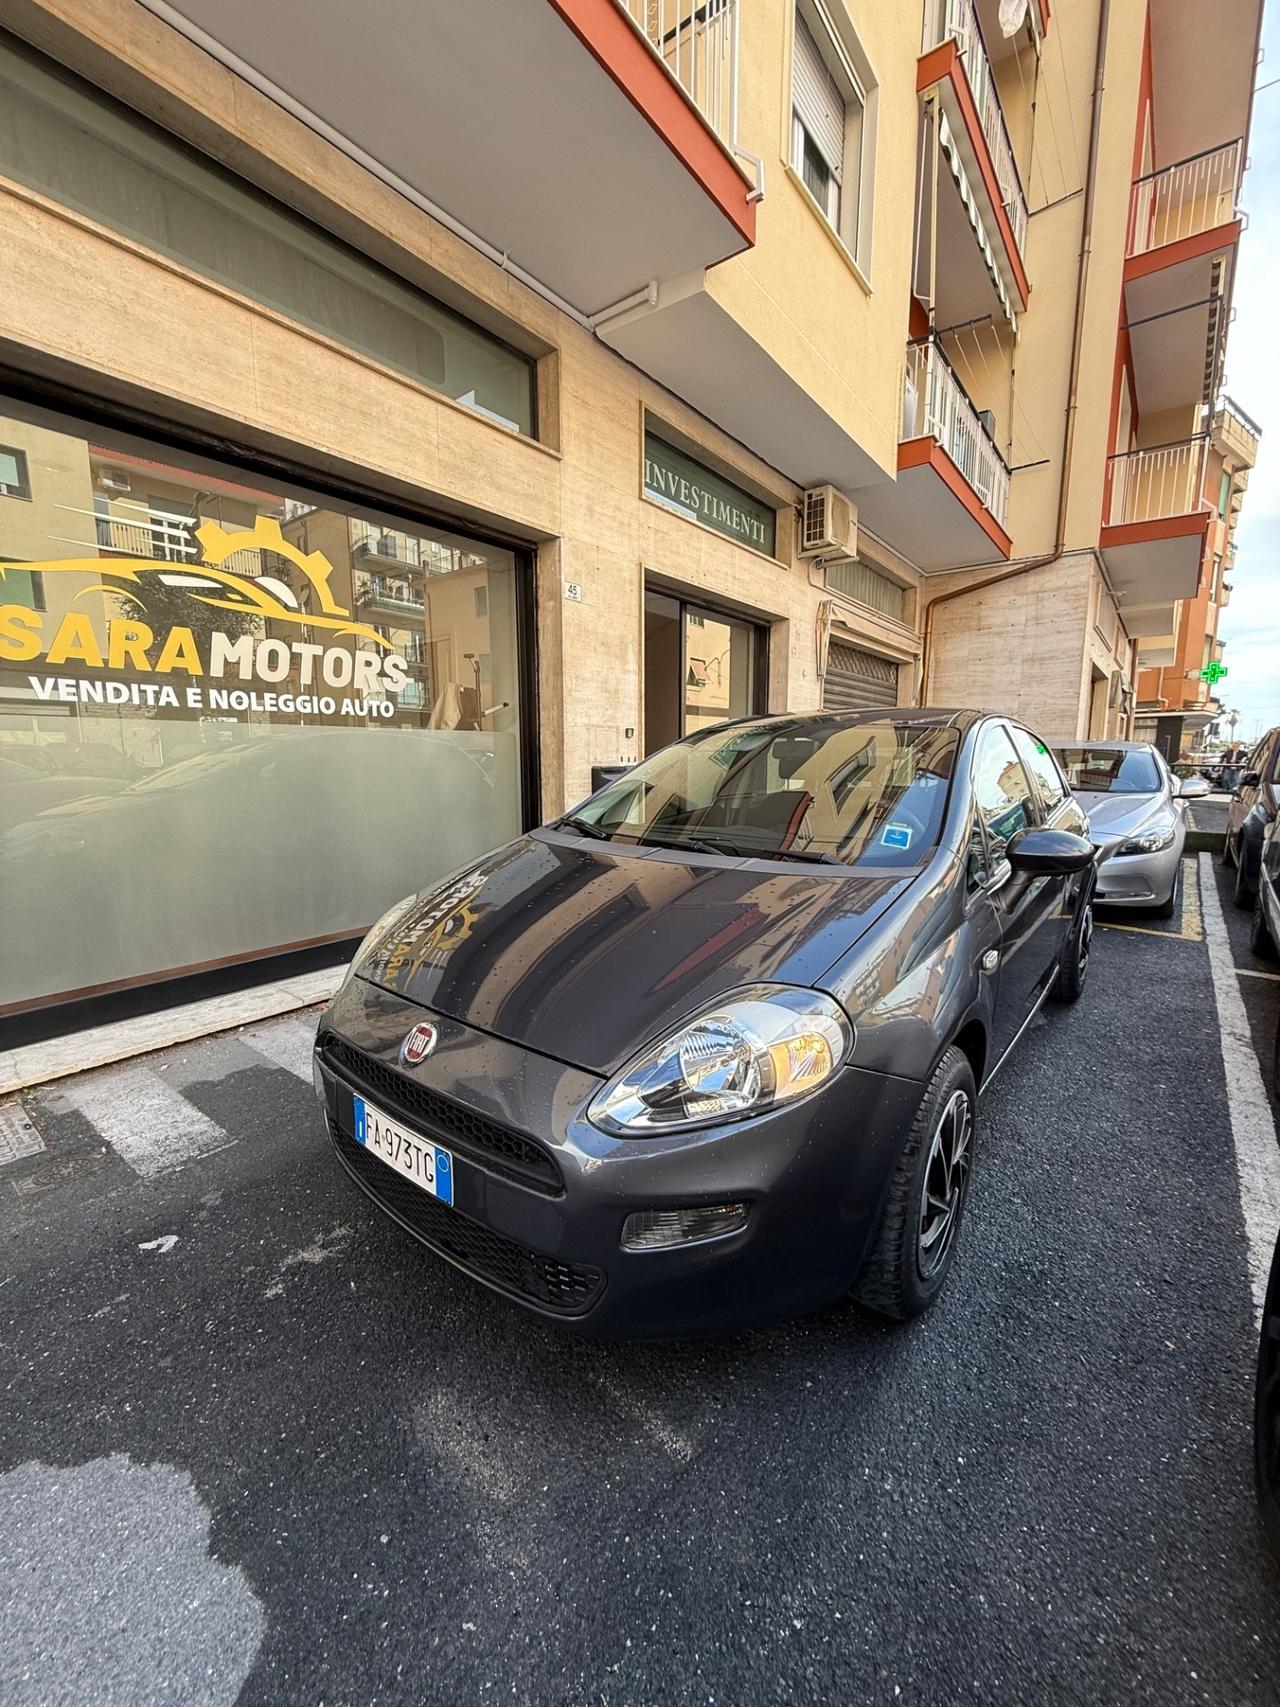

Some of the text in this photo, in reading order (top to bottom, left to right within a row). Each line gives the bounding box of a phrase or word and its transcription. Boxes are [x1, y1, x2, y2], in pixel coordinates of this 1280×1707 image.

[644, 458, 765, 544] INVESTIMENTI
[568, 584, 577, 596] 45
[28, 675, 395, 718] VENDITA E NOLEGGIO AUTO
[409, 1031, 430, 1054] FIAT
